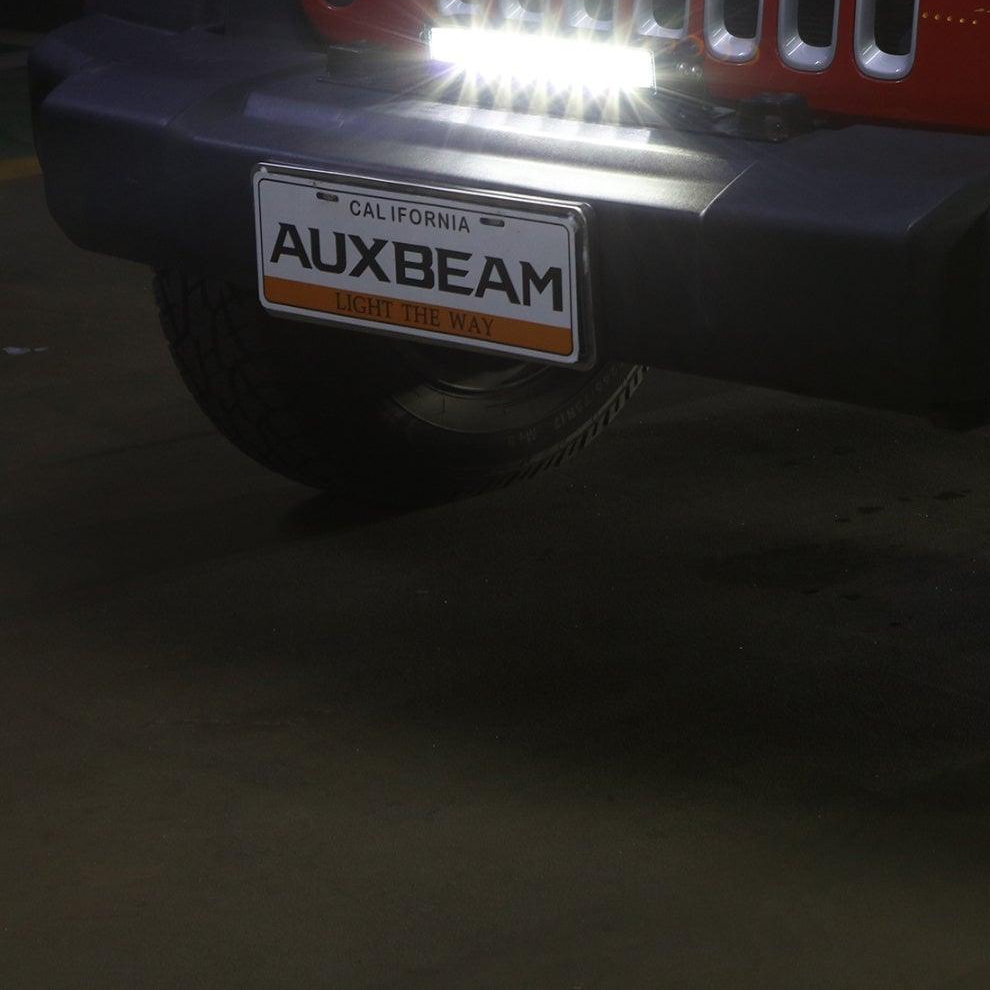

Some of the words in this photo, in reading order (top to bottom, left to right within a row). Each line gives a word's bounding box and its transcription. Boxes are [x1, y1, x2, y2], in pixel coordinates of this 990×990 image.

[349, 199, 471, 234] CALIFORNIA
[270, 221, 563, 313] AUXBEAM
[335, 291, 394, 320] LIGHT
[401, 303, 441, 328] THE
[449, 312, 495, 337] WAY
